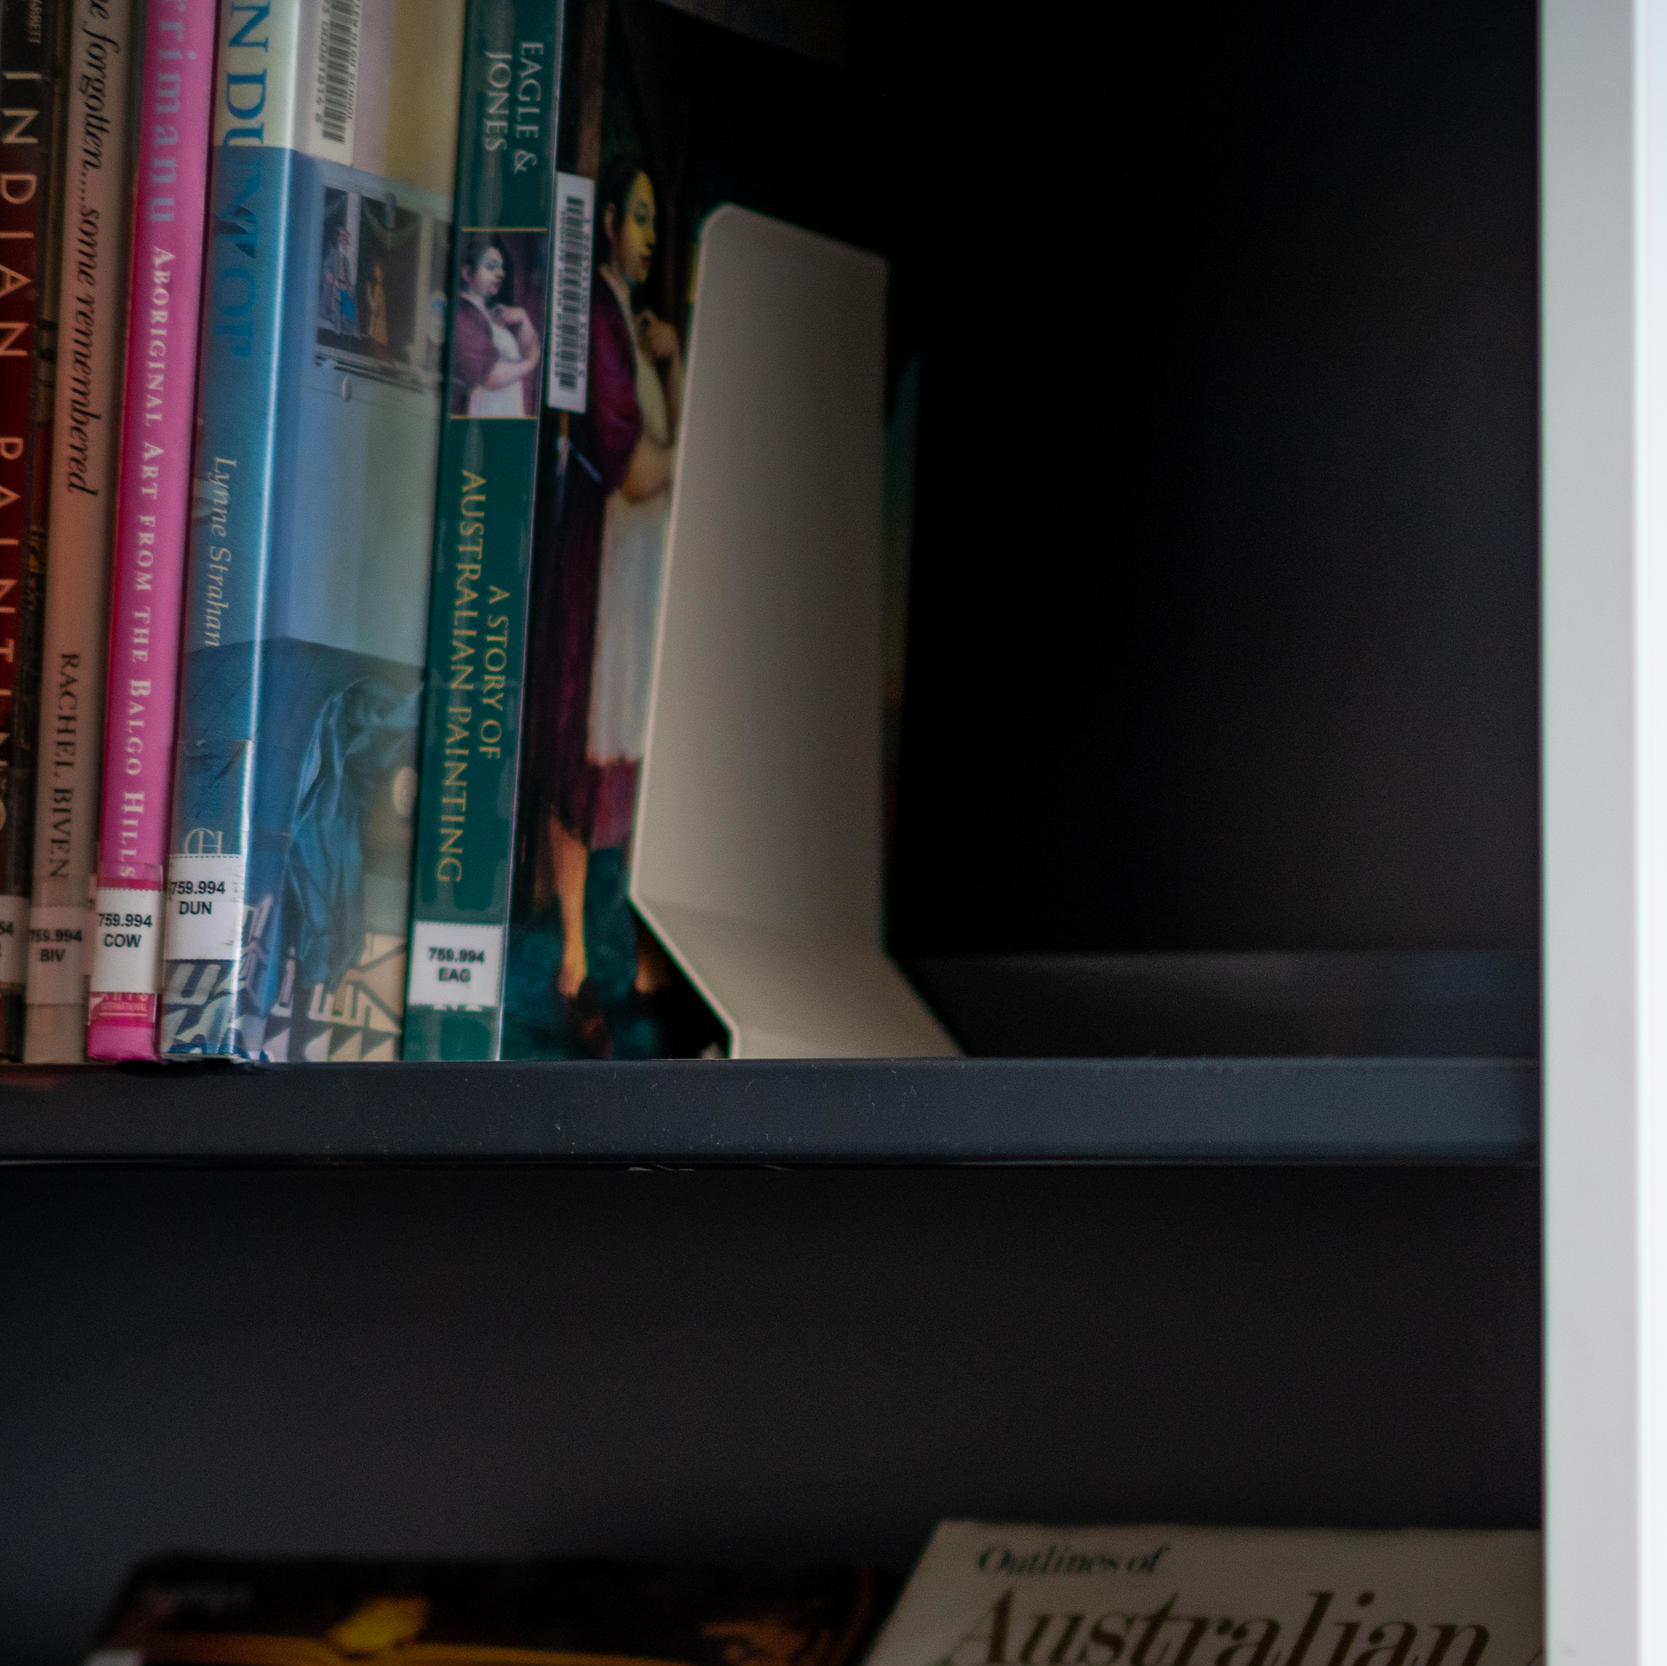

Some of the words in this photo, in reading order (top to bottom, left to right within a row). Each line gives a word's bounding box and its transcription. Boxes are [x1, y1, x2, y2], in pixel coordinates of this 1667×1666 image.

[150, 0, 197, 223] rimanu
[484, 50, 513, 151] JONES
[516, 41, 544, 139] EAGLE
[513, 149, 537, 174] &
[144, 246, 176, 427] ABORIGINAL
[67, 295, 101, 497] remembered
[140, 442, 165, 500] ART
[207, 456, 237, 537] Lynne
[135, 514, 156, 591] FROM
[450, 469, 487, 690] AUSTRALIAN
[204, 545, 232, 648] Strahan
[488, 585, 511, 604] A
[132, 606, 151, 664] THE
[482, 615, 510, 711] STORY
[54, 653, 81, 777] RACHEL
[124, 678, 151, 776] BALGO
[479, 719, 502, 759] OF
[49, 788, 73, 878] BIVEN
[118, 791, 145, 878] HILLS
[436, 707, 472, 883] PAINTING
[98, 913, 153, 927] 759.994
[171, 881, 226, 895] 759.994
[179, 901, 213, 915] DUN
[40, 948, 66, 962] BIV
[104, 934, 142, 948] COW
[428, 946, 486, 964] 759.994
[438, 967, 471, 983] EAG
[976, 1546, 1119, 1577] Outlines
[1126, 1544, 1172, 1575] of
